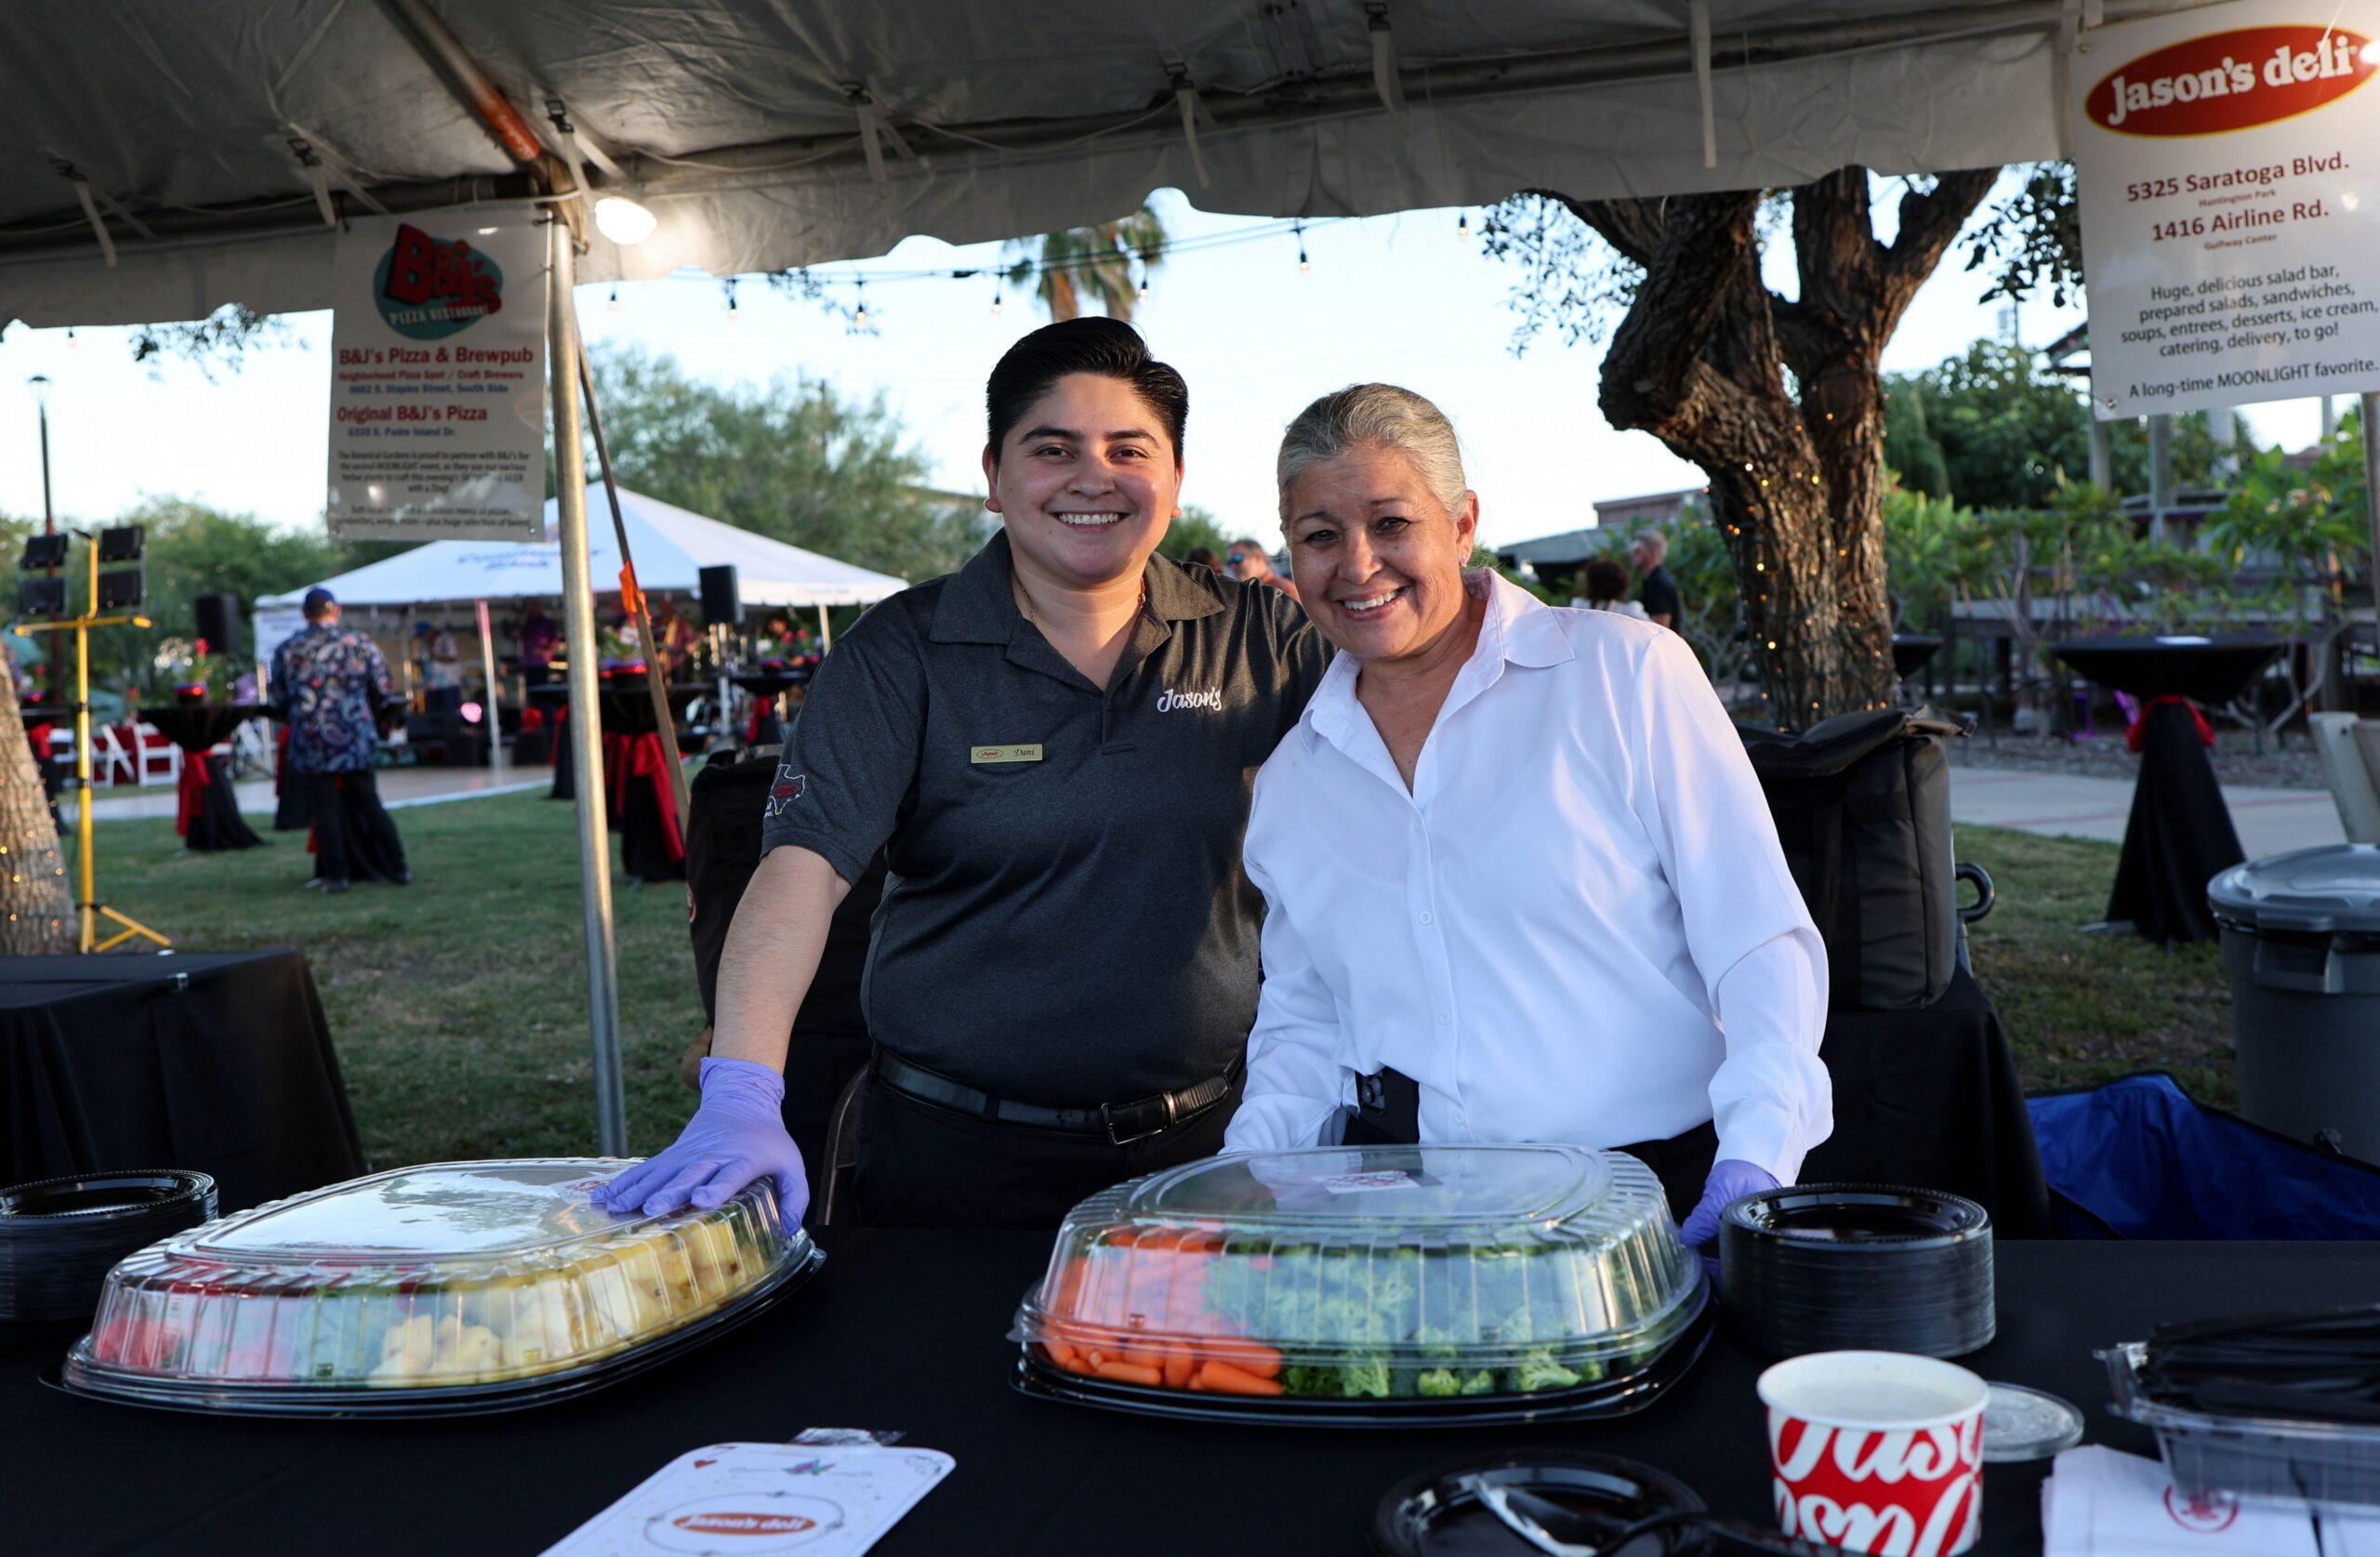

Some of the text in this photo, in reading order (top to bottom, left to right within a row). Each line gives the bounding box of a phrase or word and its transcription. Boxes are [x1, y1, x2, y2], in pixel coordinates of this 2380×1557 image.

[2108, 35, 2353, 125] Jason's deli
[2127, 152, 2349, 202] 5325 Saratoga Blvd.
[2199, 190, 2276, 207] Huntington Park
[2153, 200, 2328, 242] 1416 Airline Rd.
[2203, 234, 2277, 250] Gulfway Center
[2151, 265, 2339, 301] Huge, delicious salad bar,
[2139, 282, 2355, 323] prepared salads, sandwiches,
[389, 310, 426, 324] PIZZA
[2122, 301, 2378, 343] soups, entrees, desserts, ice cream,
[2160, 322, 2339, 357] catering, delivery, to go!
[339, 347, 533, 366] B&J's Pizza & Brewpub
[399, 371, 421, 379] Pizza
[424, 371, 444, 381] Spot
[457, 370, 479, 379] Craft
[483, 370, 523, 379] Brewers
[2129, 358, 2378, 398] A long-time MOONLIGHT favorite.
[374, 385, 382, 393] S.
[386, 385, 417, 394] Staples
[422, 384, 453, 394] Street,
[456, 384, 483, 393] South
[487, 384, 509, 393] Side
[337, 404, 487, 424] Original B&J's Pizza
[373, 428, 381, 436] S.
[385, 428, 408, 436] Padre
[413, 428, 440, 436] Island
[443, 428, 456, 436] Dr.
[1157, 686, 1223, 713] Jason's
[1014, 747, 1035, 757] Dani
[760, 1517, 807, 1530] deli
